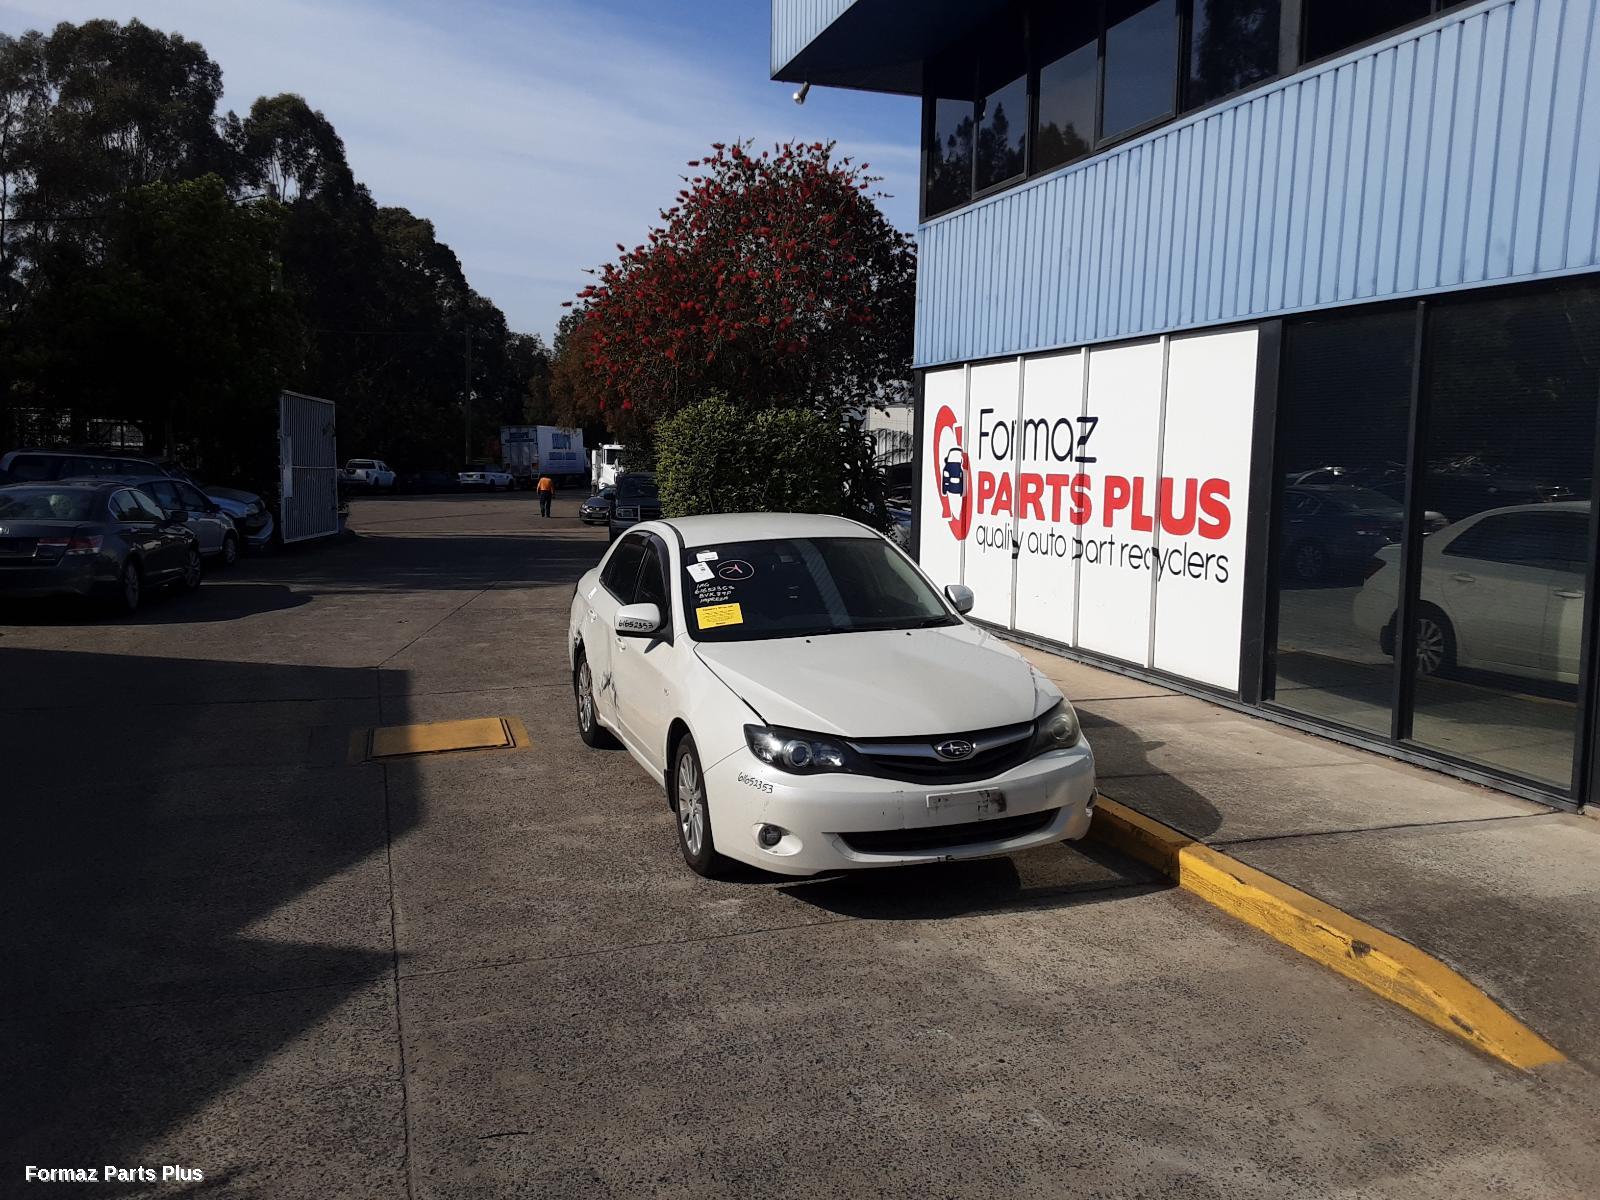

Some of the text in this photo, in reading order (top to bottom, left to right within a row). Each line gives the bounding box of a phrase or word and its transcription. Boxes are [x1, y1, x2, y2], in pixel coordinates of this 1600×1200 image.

[978, 408, 1099, 464] Formaz
[977, 471, 1231, 540] PARTS PLUS
[976, 523, 1024, 559] qualiy
[1027, 527, 1067, 557] auto
[1120, 541, 1229, 584] recyclers
